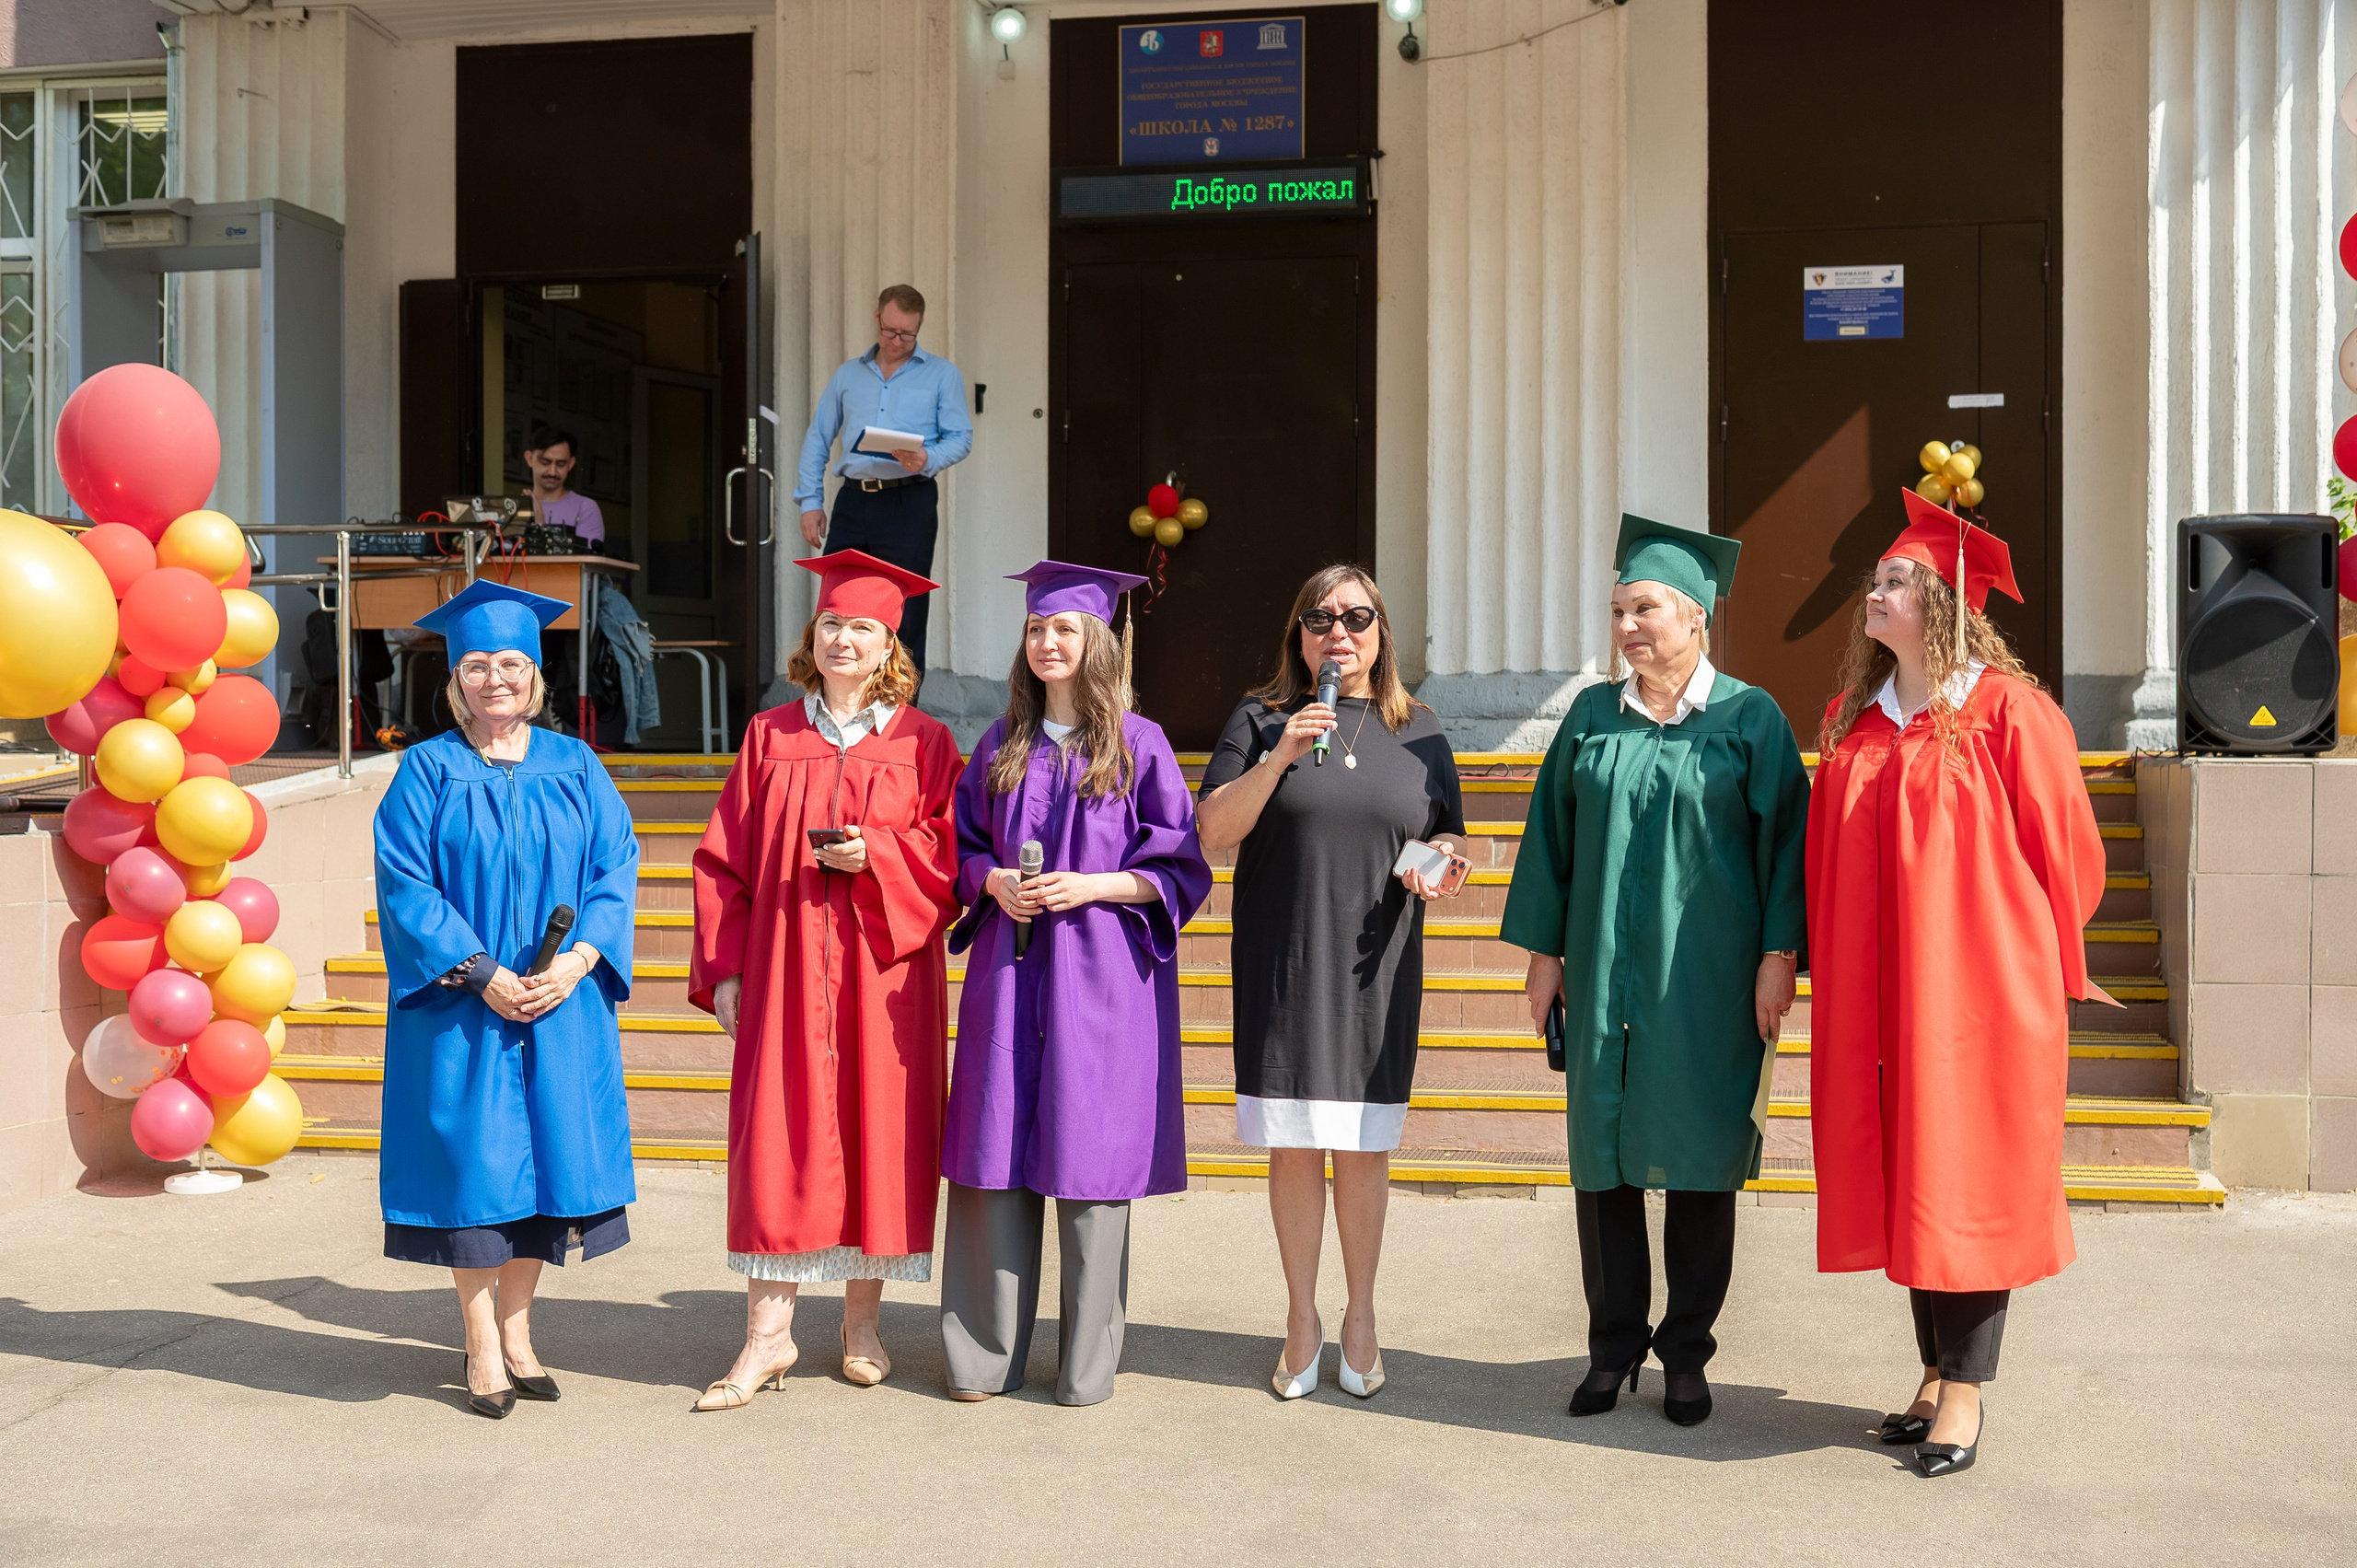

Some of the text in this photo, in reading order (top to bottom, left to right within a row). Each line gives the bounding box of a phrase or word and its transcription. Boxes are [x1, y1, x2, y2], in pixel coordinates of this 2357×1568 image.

[1175, 101, 1209, 110] ГОРОДА
[1129, 115, 1295, 136] «ШКОЛА № 1287»
[1171, 178, 1353, 211] Добро пожал
